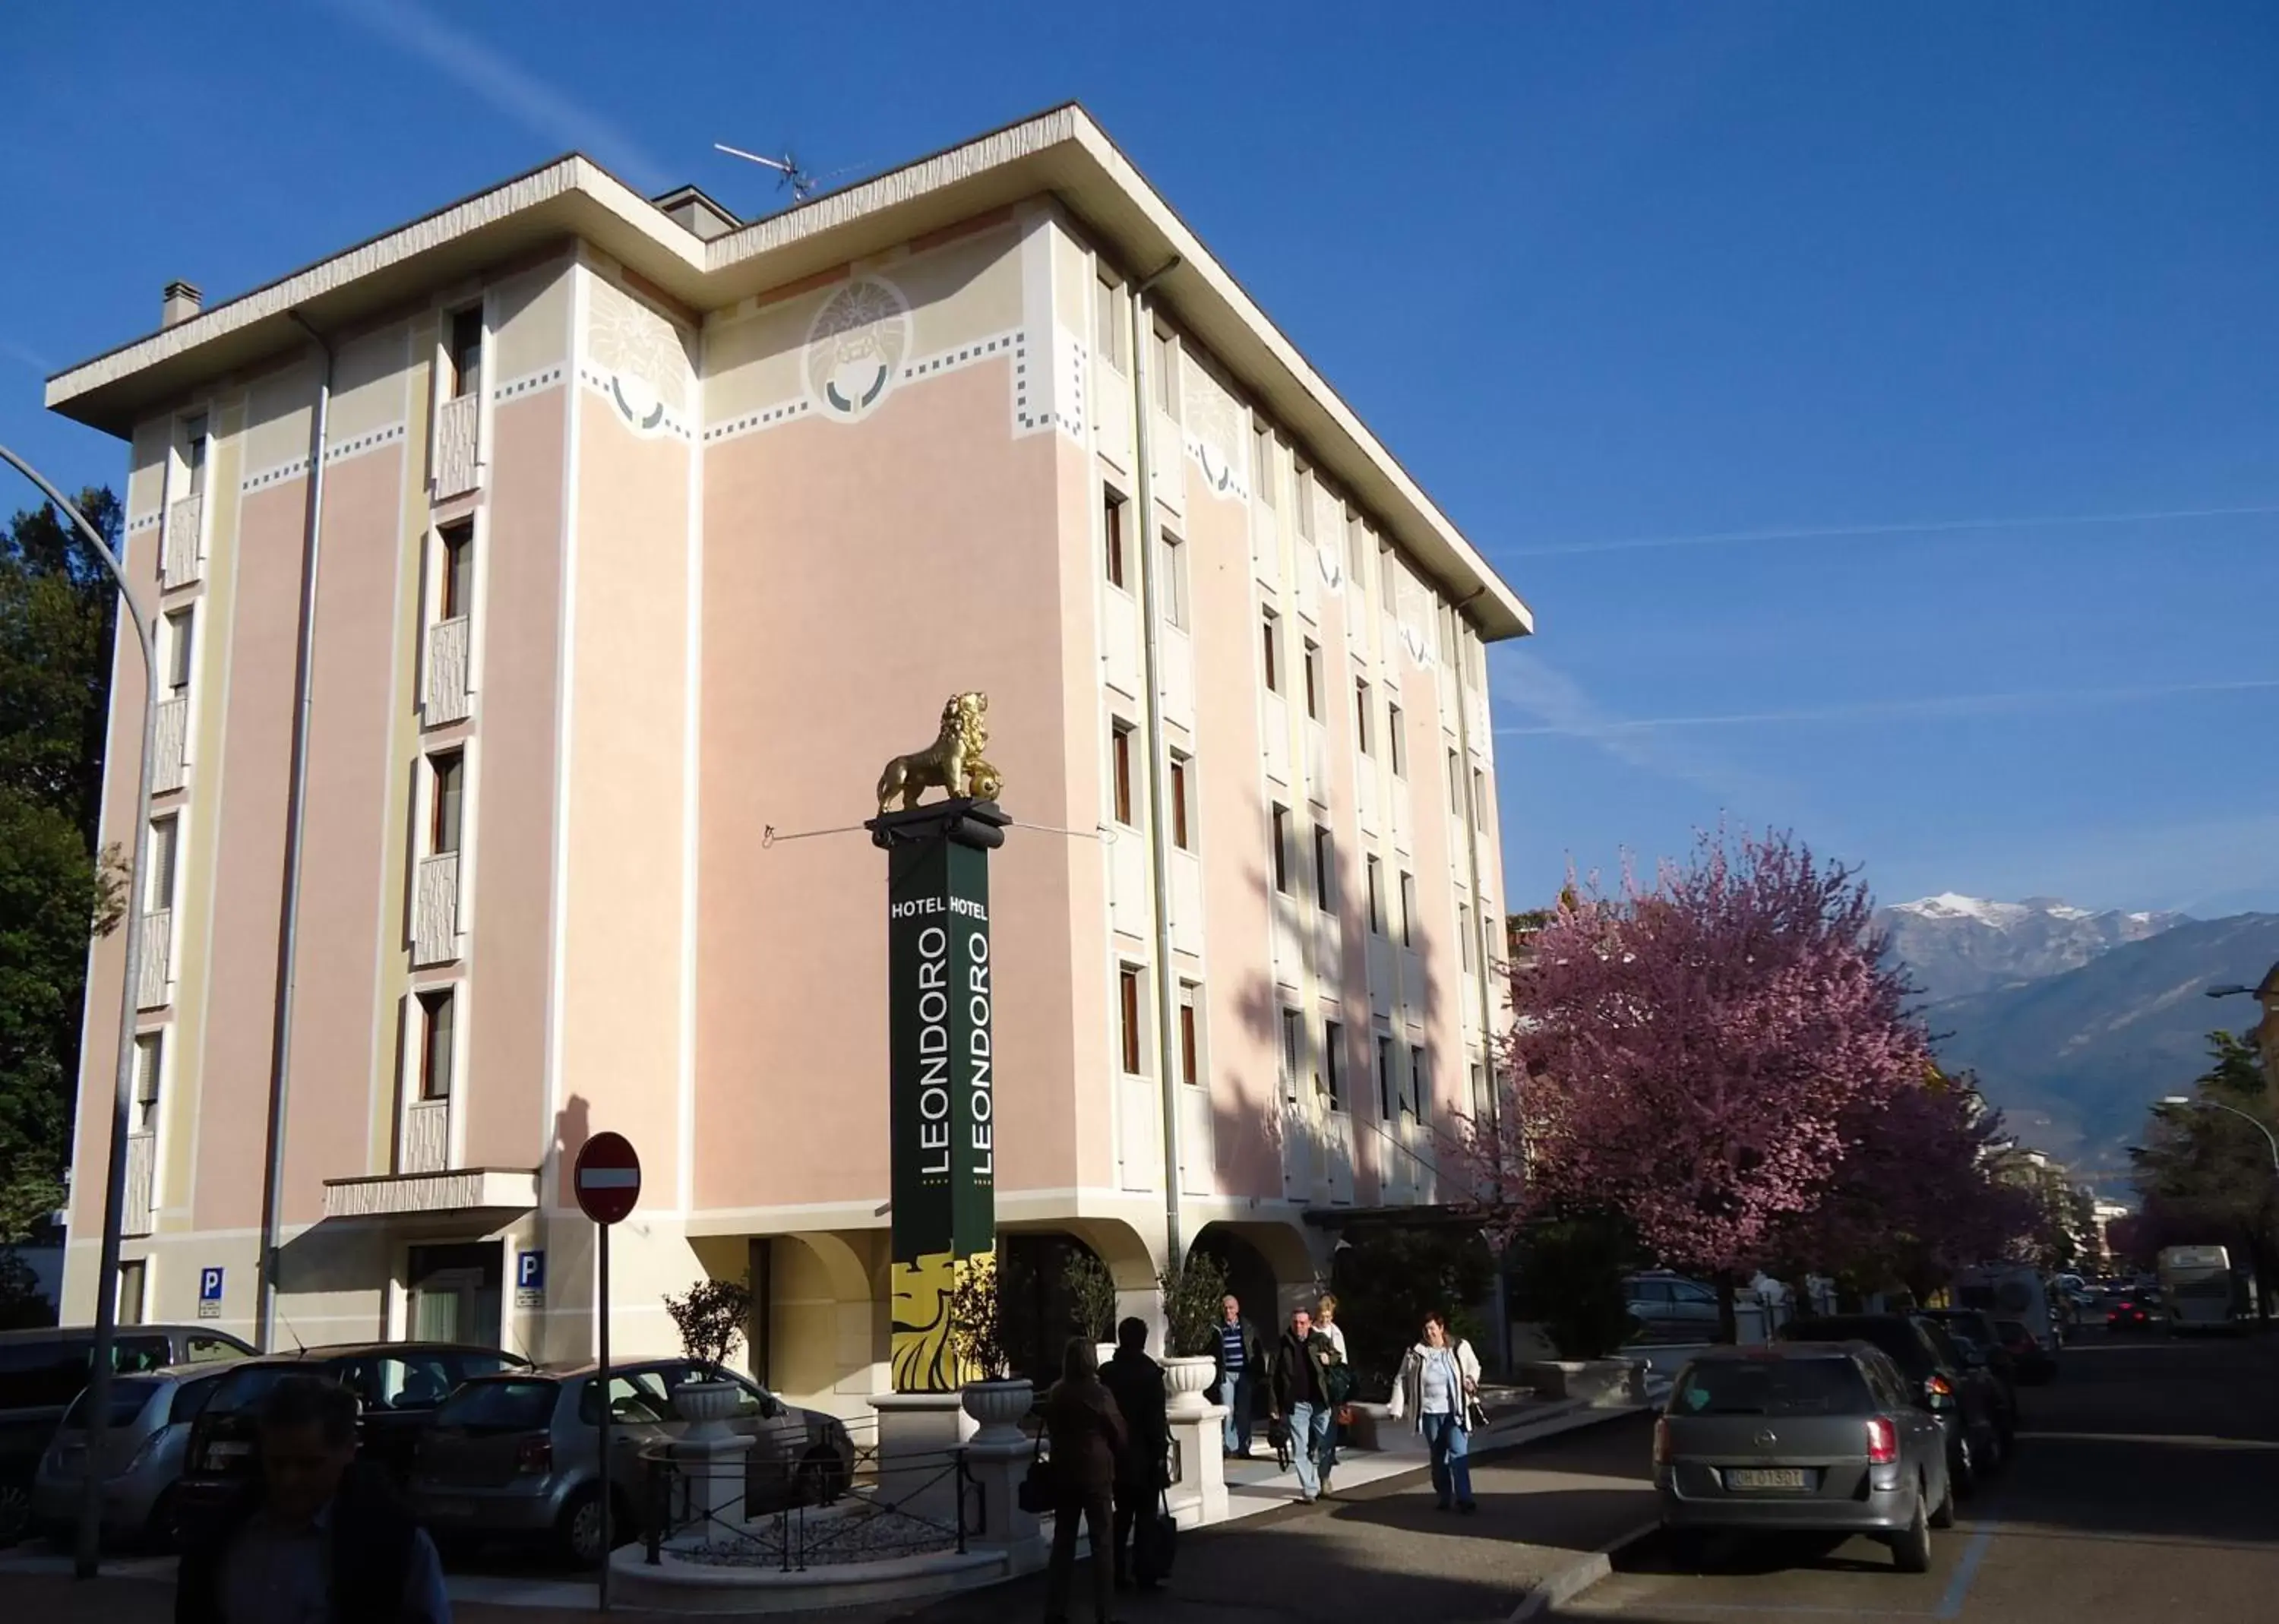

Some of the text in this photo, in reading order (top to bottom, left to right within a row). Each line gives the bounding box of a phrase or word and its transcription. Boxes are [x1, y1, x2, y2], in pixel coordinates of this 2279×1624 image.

[892, 897, 946, 918] HOTEL
[950, 896, 988, 921] HOTEL
[918, 927, 950, 1174] LEONDORO
[969, 931, 992, 1174] LEONDORO
[522, 1256, 538, 1284] P
[204, 1271, 219, 1297] P
